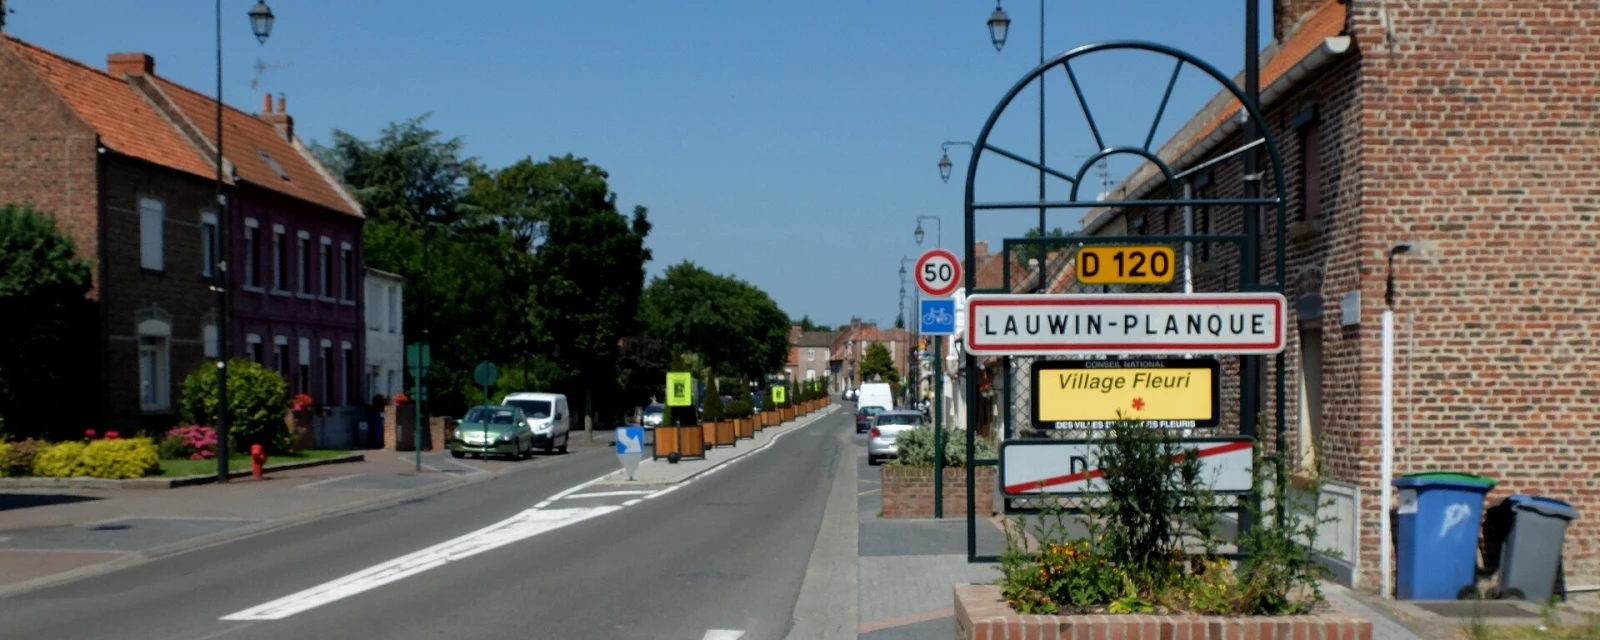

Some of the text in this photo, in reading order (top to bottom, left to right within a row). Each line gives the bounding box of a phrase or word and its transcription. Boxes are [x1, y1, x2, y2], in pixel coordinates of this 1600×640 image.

[924, 264, 952, 282] 50
[1081, 251, 1169, 277] D 120
[985, 313, 1265, 337] LAUWIN-PLANQUE
[1085, 360, 1165, 368] CONSEIL NATIONAL
[1059, 372, 1191, 393] Village Fleuri
[1055, 420, 1073, 429] DES
[1159, 419, 1196, 428] FLEURIS
